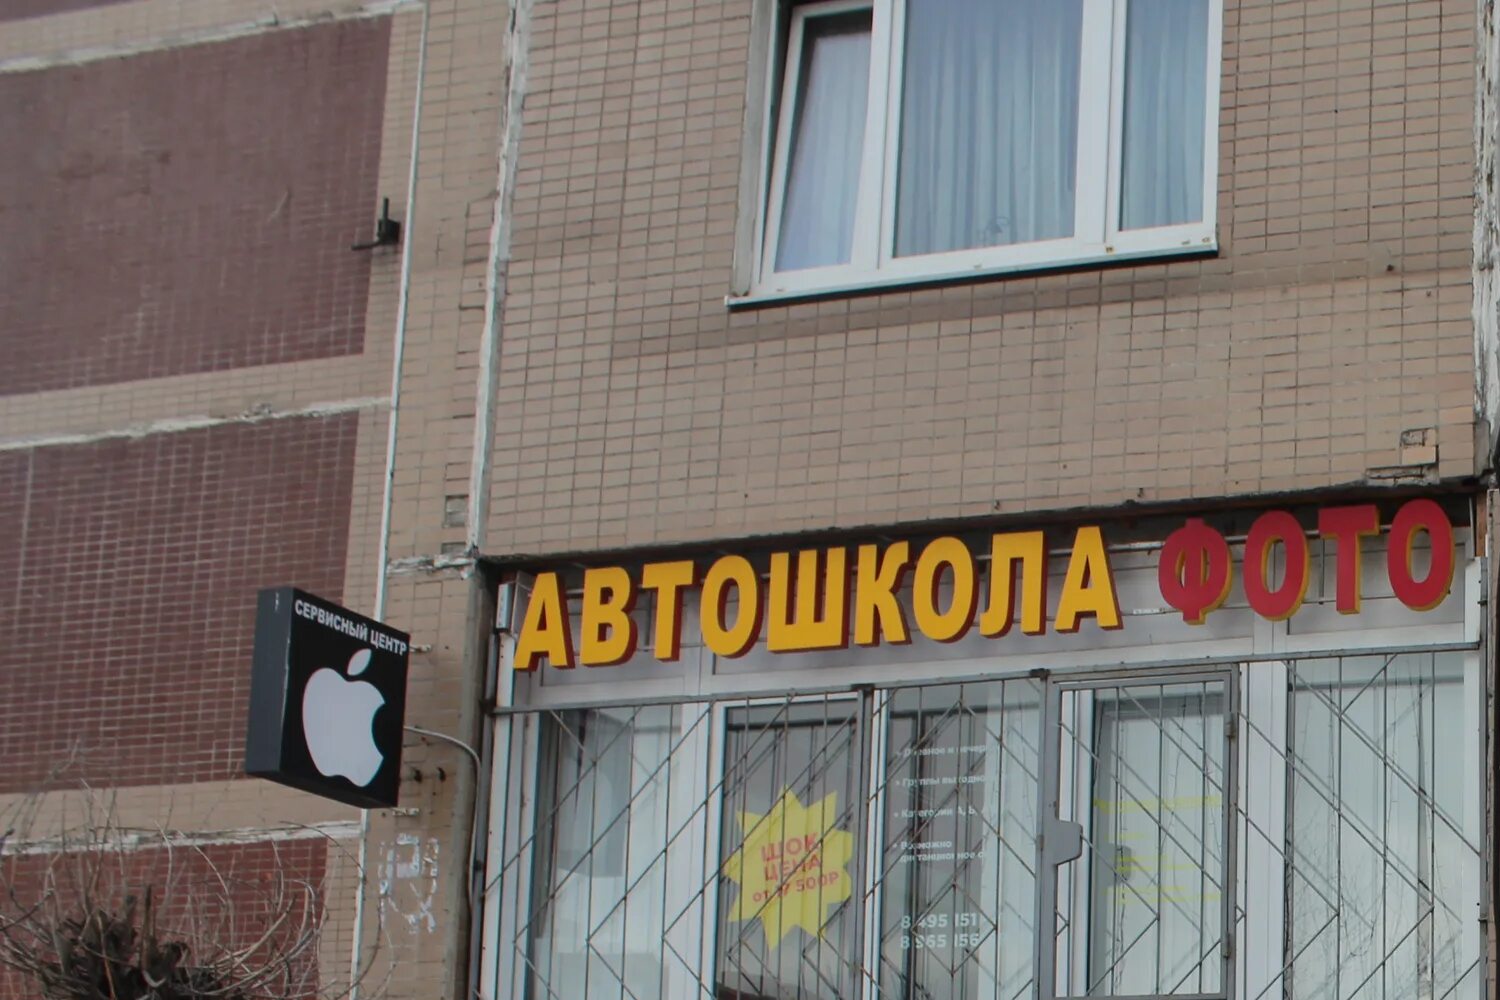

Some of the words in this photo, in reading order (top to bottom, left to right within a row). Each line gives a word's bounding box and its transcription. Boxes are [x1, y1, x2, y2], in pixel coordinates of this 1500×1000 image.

[294, 599, 369, 642] СЕРВИСНЫЙ
[370, 629, 408, 656] ЦЕНТР
[513, 525, 1122, 671] АВТОШКОЛА
[1156, 499, 1456, 625] ФОТО
